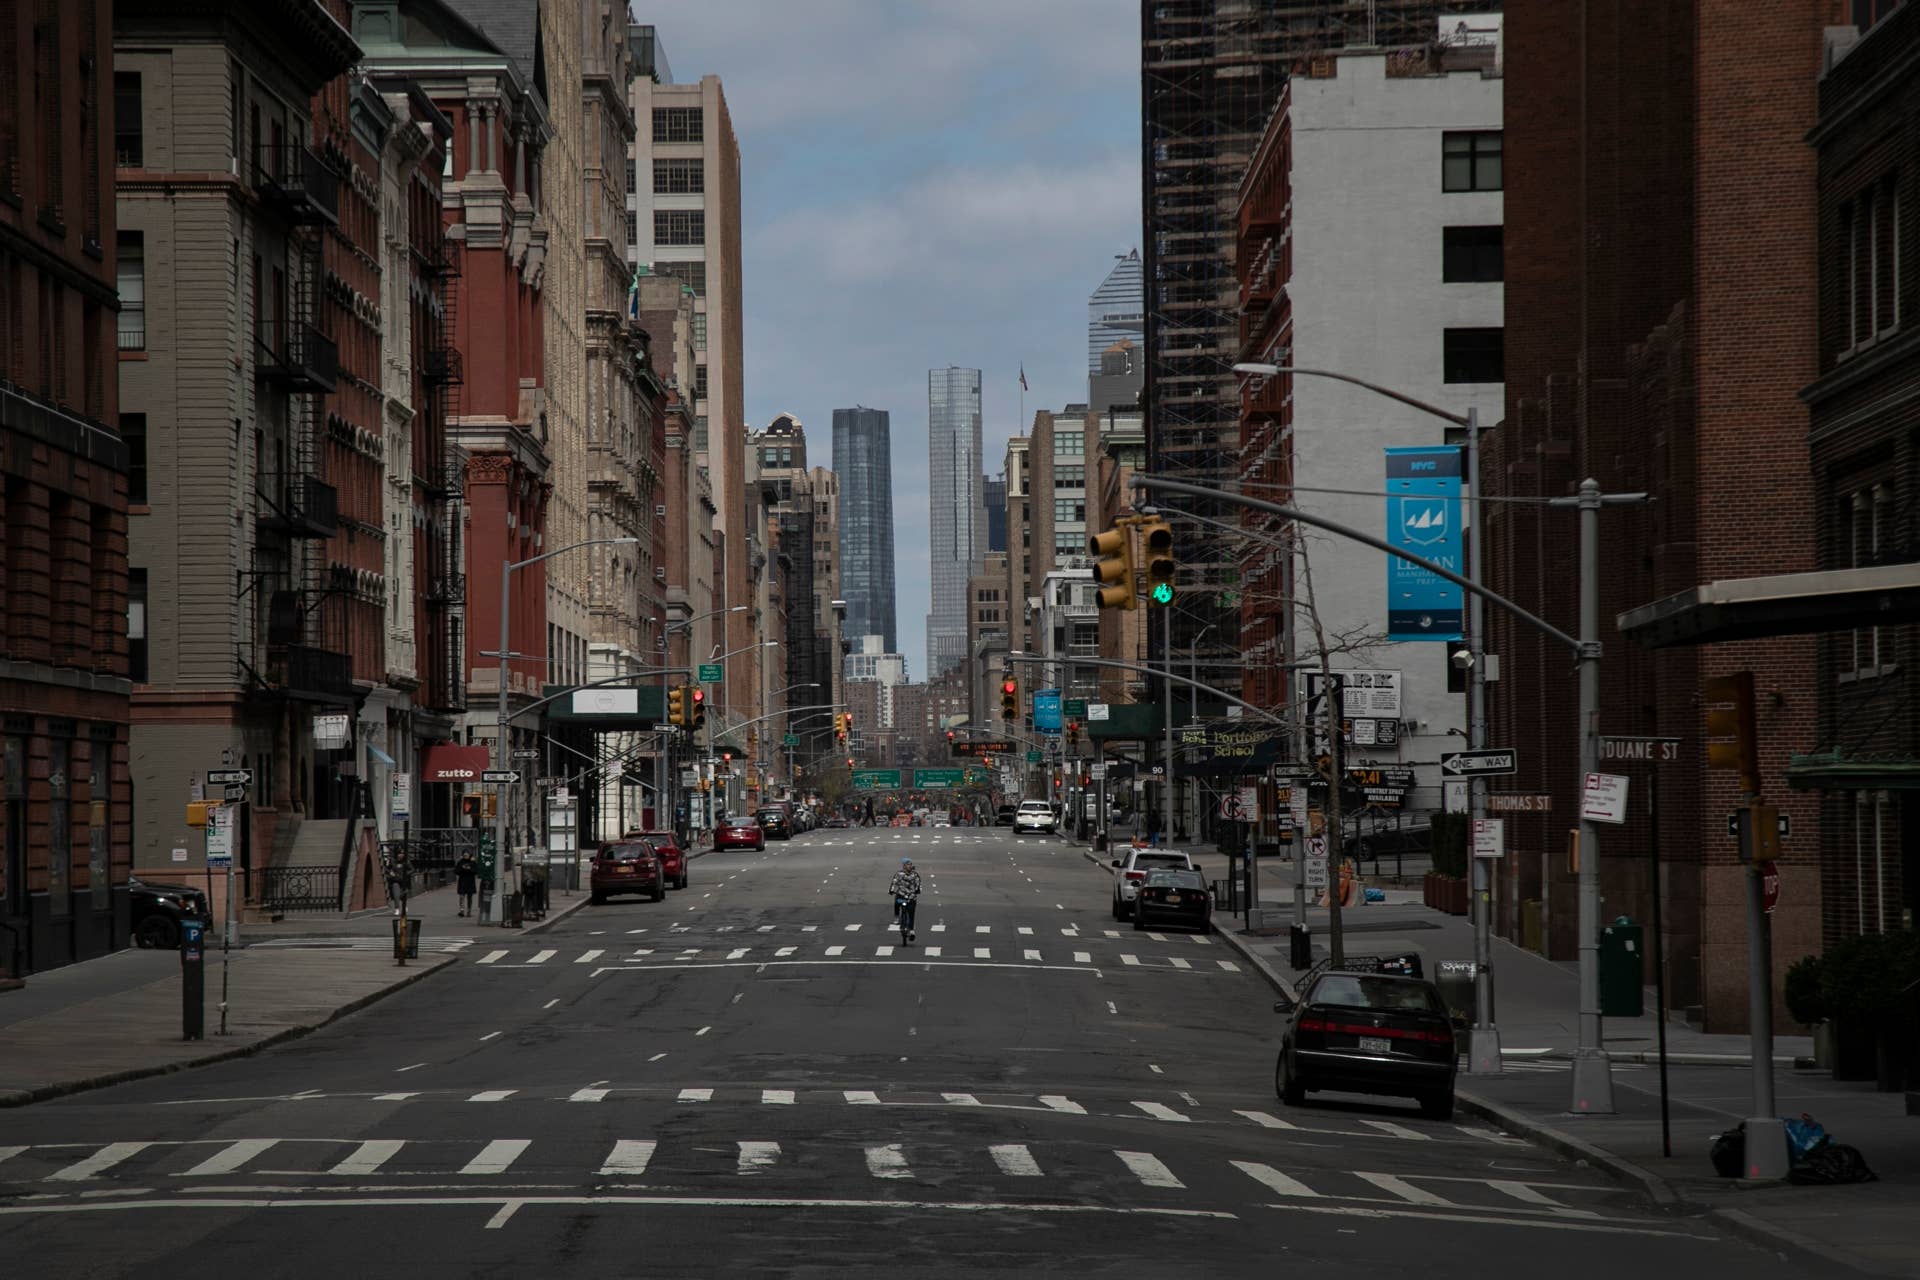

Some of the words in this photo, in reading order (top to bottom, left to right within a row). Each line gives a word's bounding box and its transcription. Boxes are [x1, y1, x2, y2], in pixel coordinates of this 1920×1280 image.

[1606, 742, 1654, 759] DUANE
[1661, 742, 1680, 760] ST
[1450, 759, 1473, 768] ONE
[1484, 757, 1508, 766] WAY
[437, 769, 474, 778] zutto
[1491, 796, 1532, 810] THOMAS
[1536, 796, 1550, 810] ST
[1764, 875, 1778, 896] TOP
[190, 930, 199, 941] P
